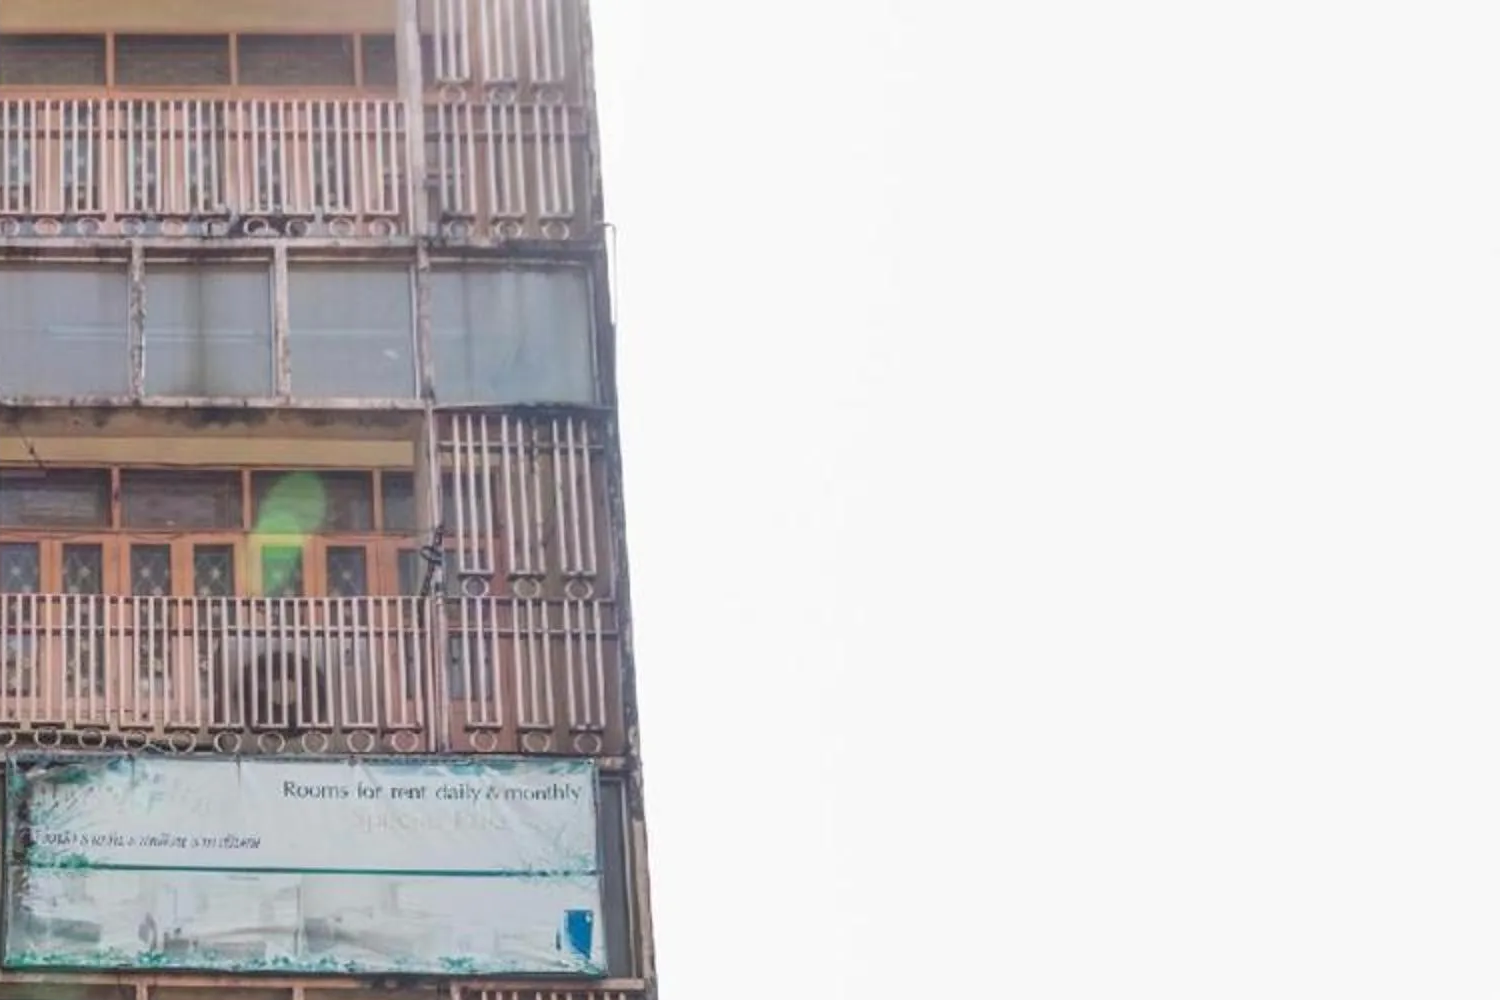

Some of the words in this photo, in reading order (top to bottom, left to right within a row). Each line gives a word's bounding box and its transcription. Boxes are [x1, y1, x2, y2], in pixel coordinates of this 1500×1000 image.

[282, 780, 350, 799] Rooms
[356, 781, 384, 799] for
[390, 785, 428, 799] rent
[435, 783, 481, 804] daily
[504, 783, 584, 804] monthly
